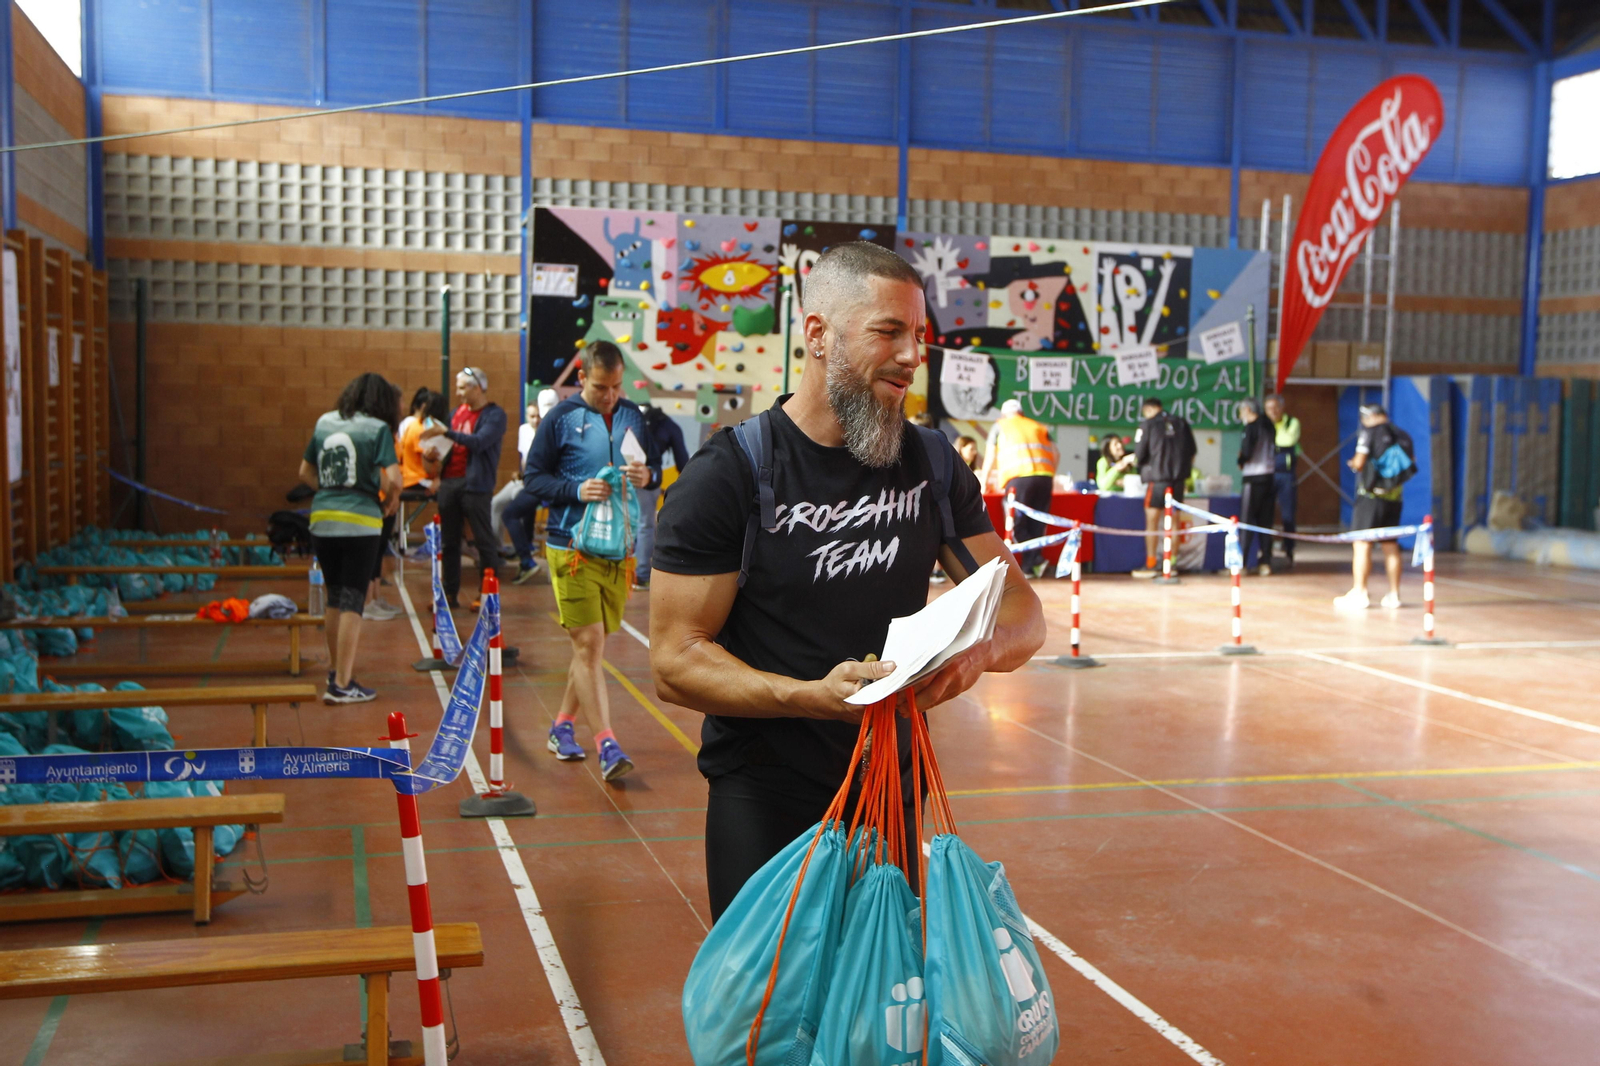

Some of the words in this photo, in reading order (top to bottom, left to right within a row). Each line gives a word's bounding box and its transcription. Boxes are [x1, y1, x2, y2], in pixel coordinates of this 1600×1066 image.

[1213, 366, 1247, 392] AL
[1012, 390, 1100, 421] TUNEL
[1108, 395, 1146, 424] DEL
[806, 535, 900, 584] TEAM
[46, 762, 138, 779] Ayuntamiento
[283, 763, 299, 776] de
[301, 760, 350, 775] Almería
